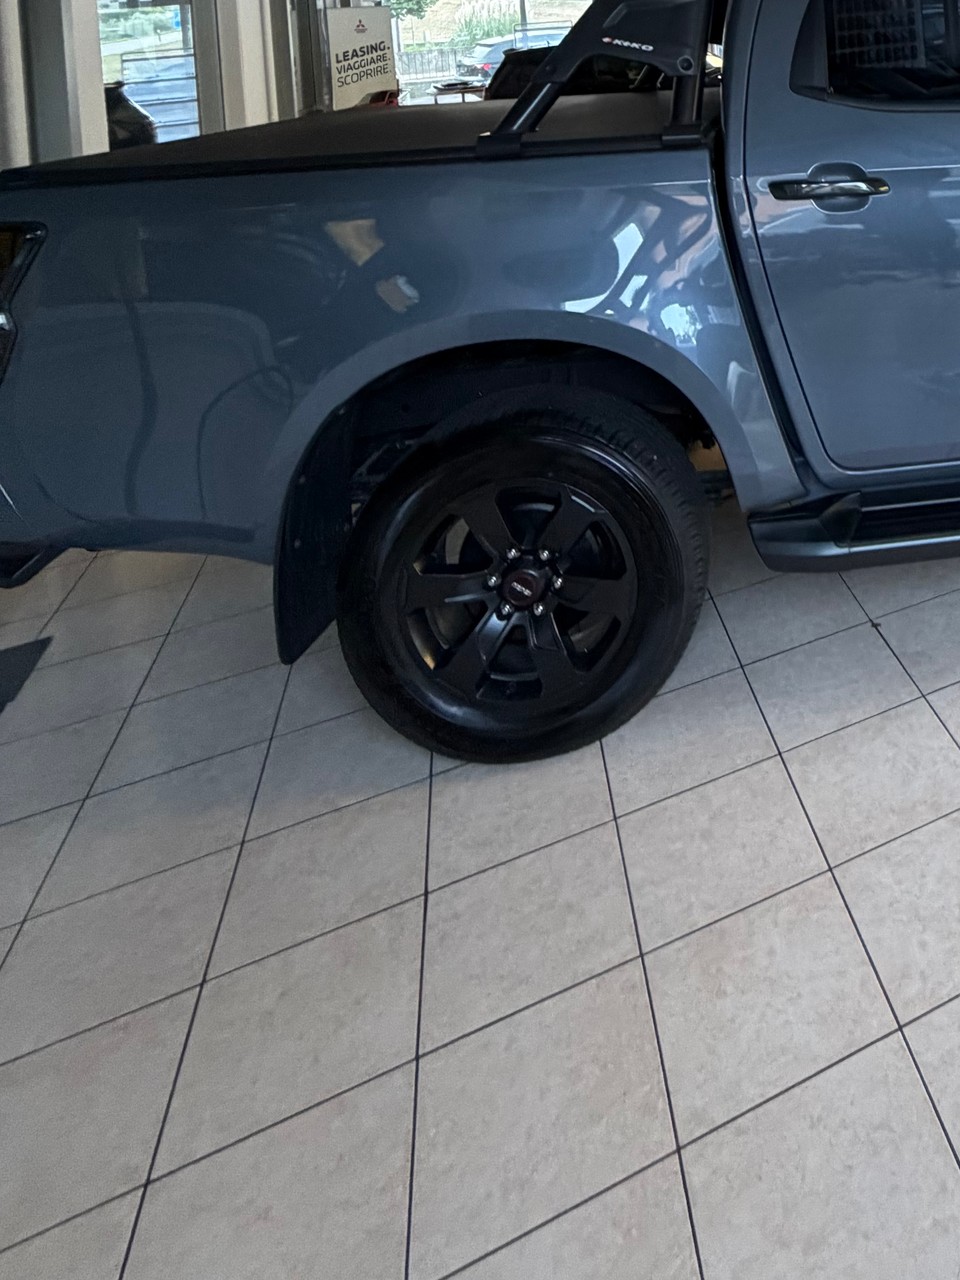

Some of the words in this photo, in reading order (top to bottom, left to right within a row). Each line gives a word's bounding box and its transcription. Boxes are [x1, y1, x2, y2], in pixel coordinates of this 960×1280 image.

[335, 41, 390, 63] LEASING.
[336, 53, 391, 74] VIAGGIARE.
[337, 64, 391, 88] SCOPRIRE.
